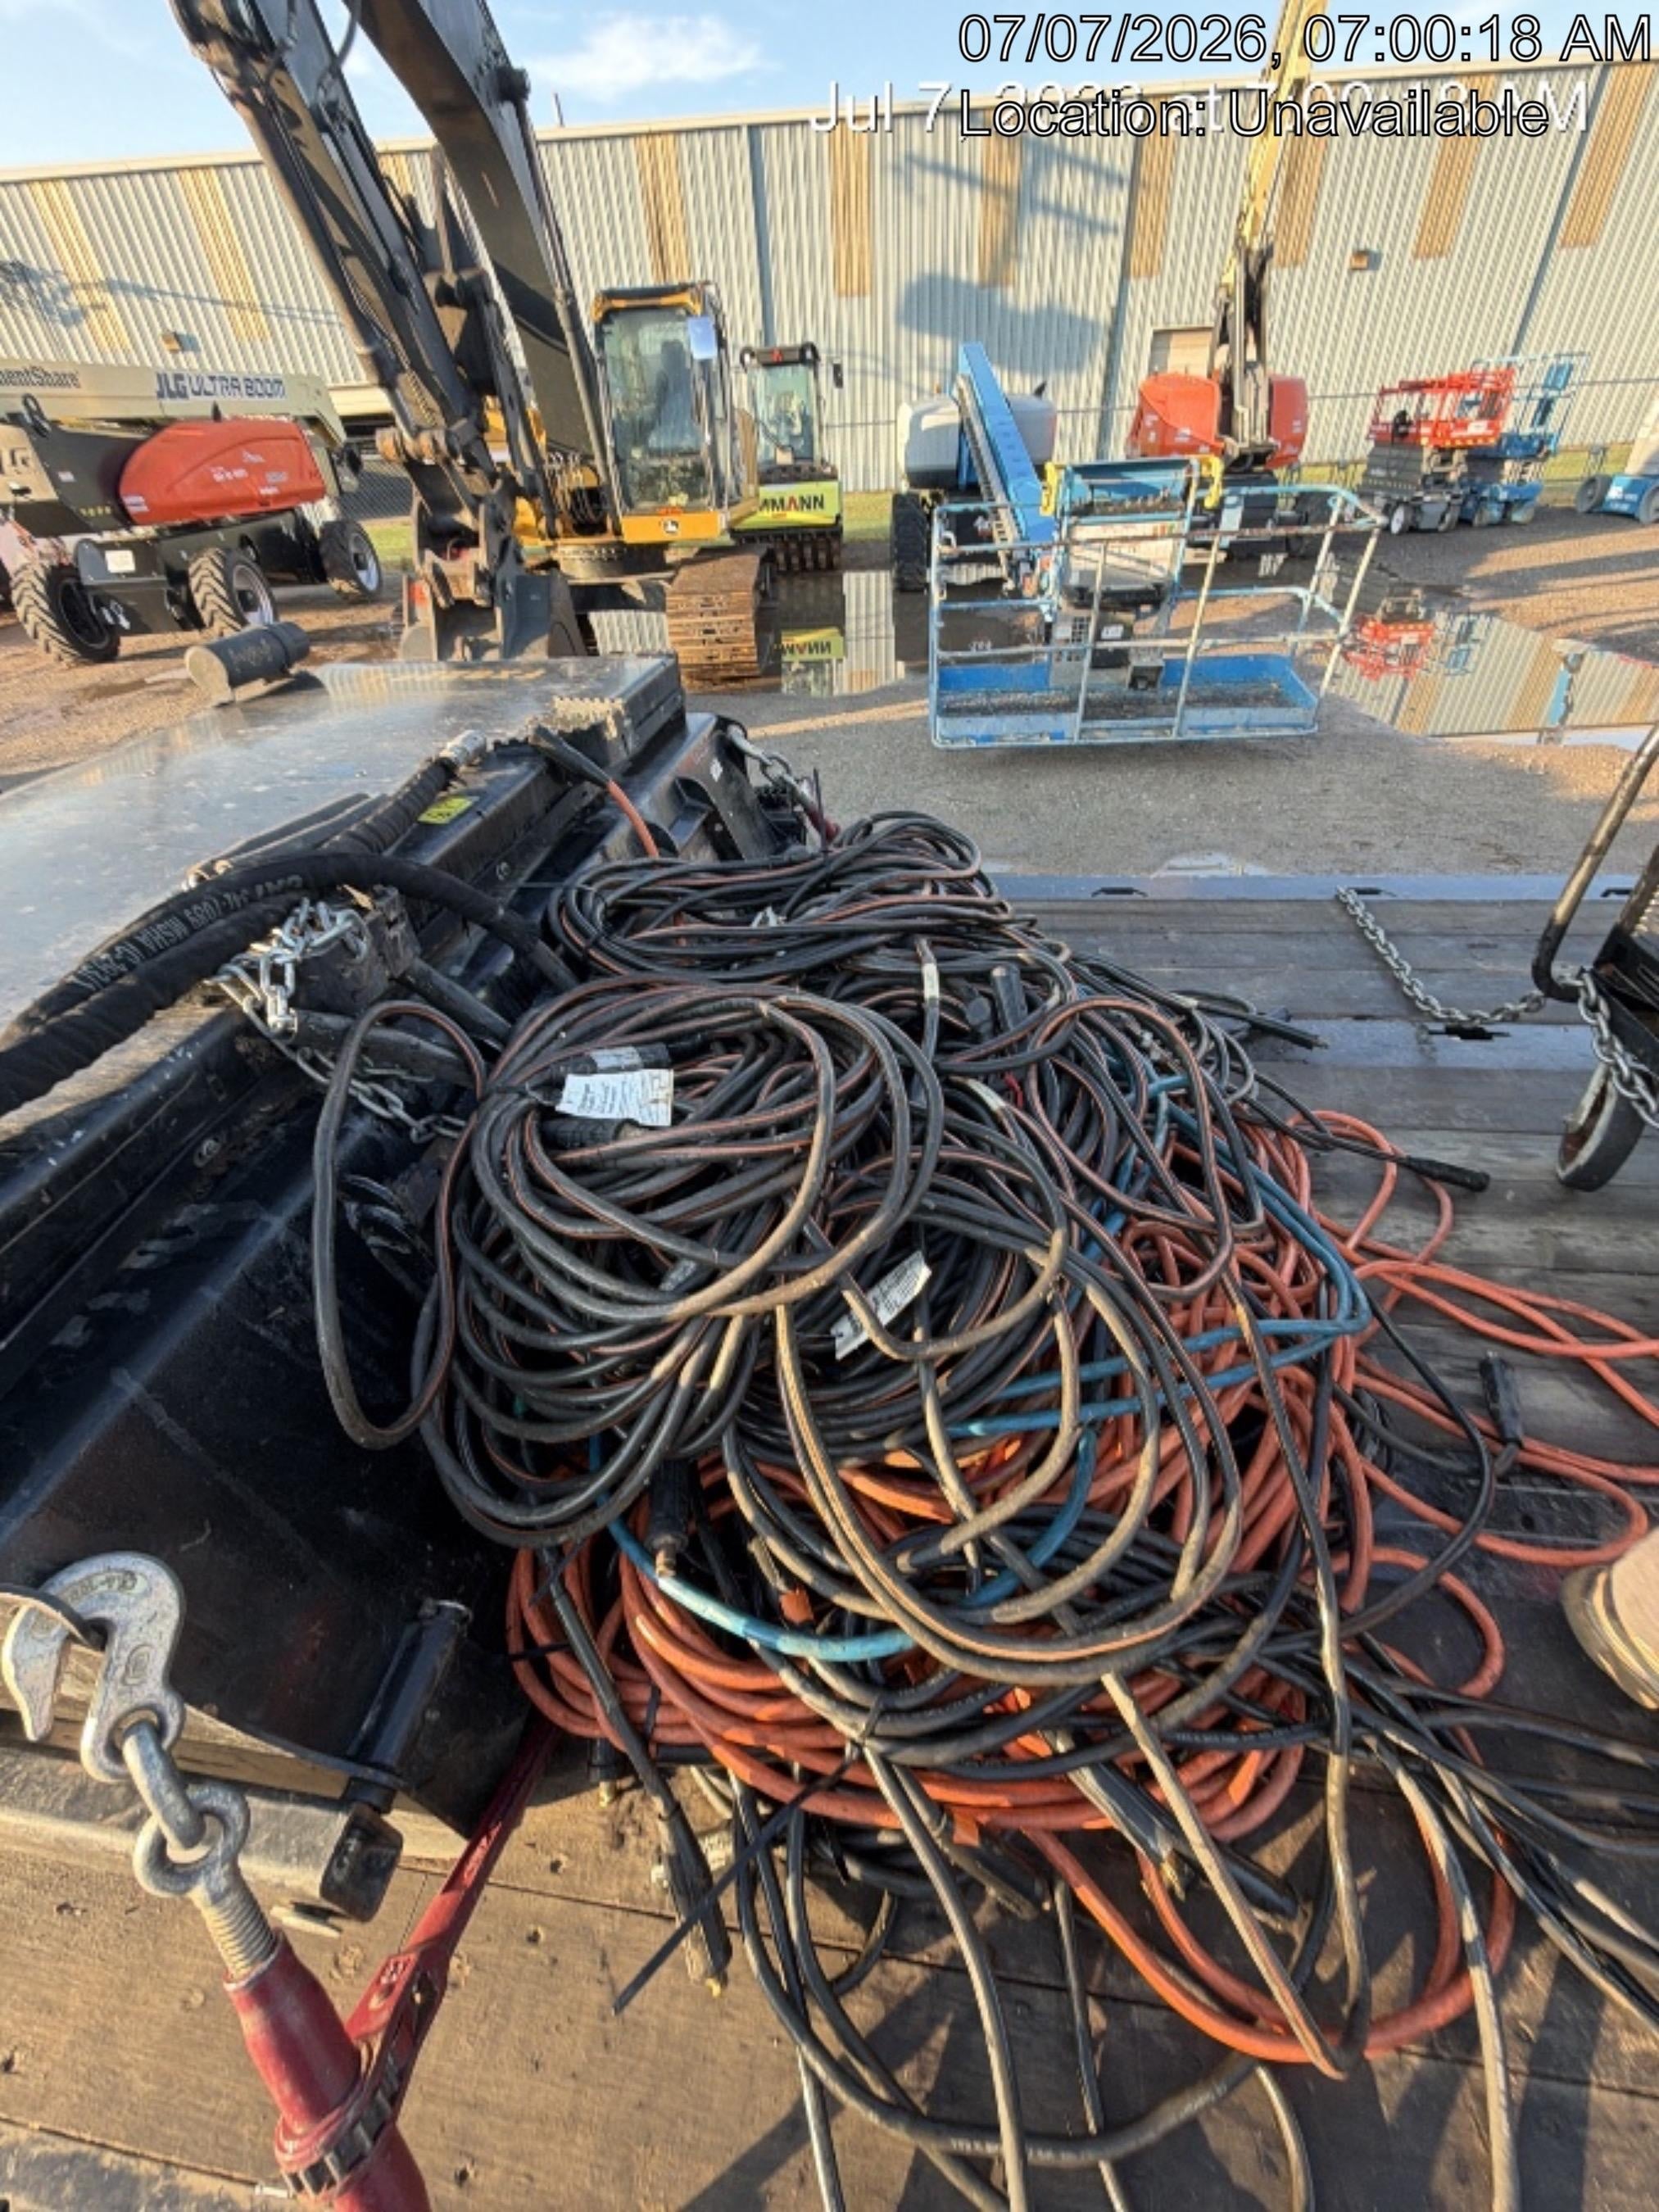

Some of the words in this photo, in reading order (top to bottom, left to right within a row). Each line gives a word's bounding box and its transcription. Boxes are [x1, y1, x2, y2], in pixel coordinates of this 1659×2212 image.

[156, 373, 189, 400] JLG
[189, 374, 243, 398] ULTRA
[243, 378, 286, 399] BOOM
